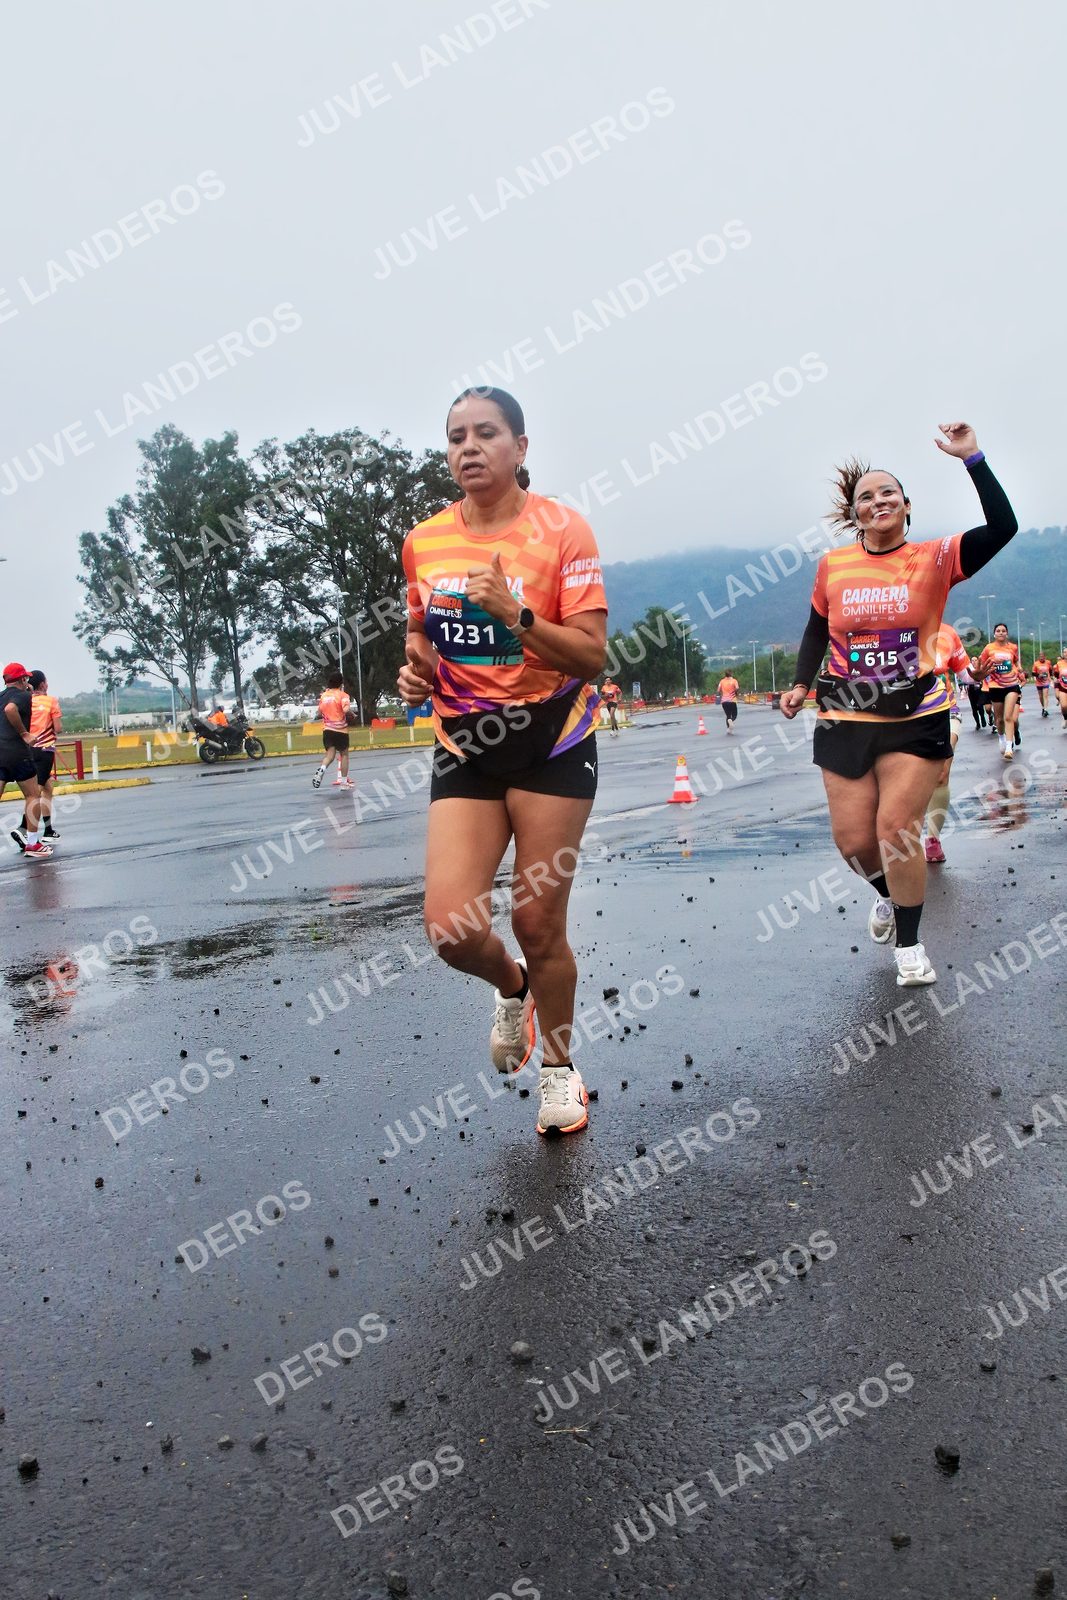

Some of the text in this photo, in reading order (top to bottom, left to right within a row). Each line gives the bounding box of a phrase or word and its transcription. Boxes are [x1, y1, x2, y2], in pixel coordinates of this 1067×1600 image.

[842, 584, 909, 605] CARRERA
[440, 622, 495, 644] 1231
[864, 650, 898, 667] 615
